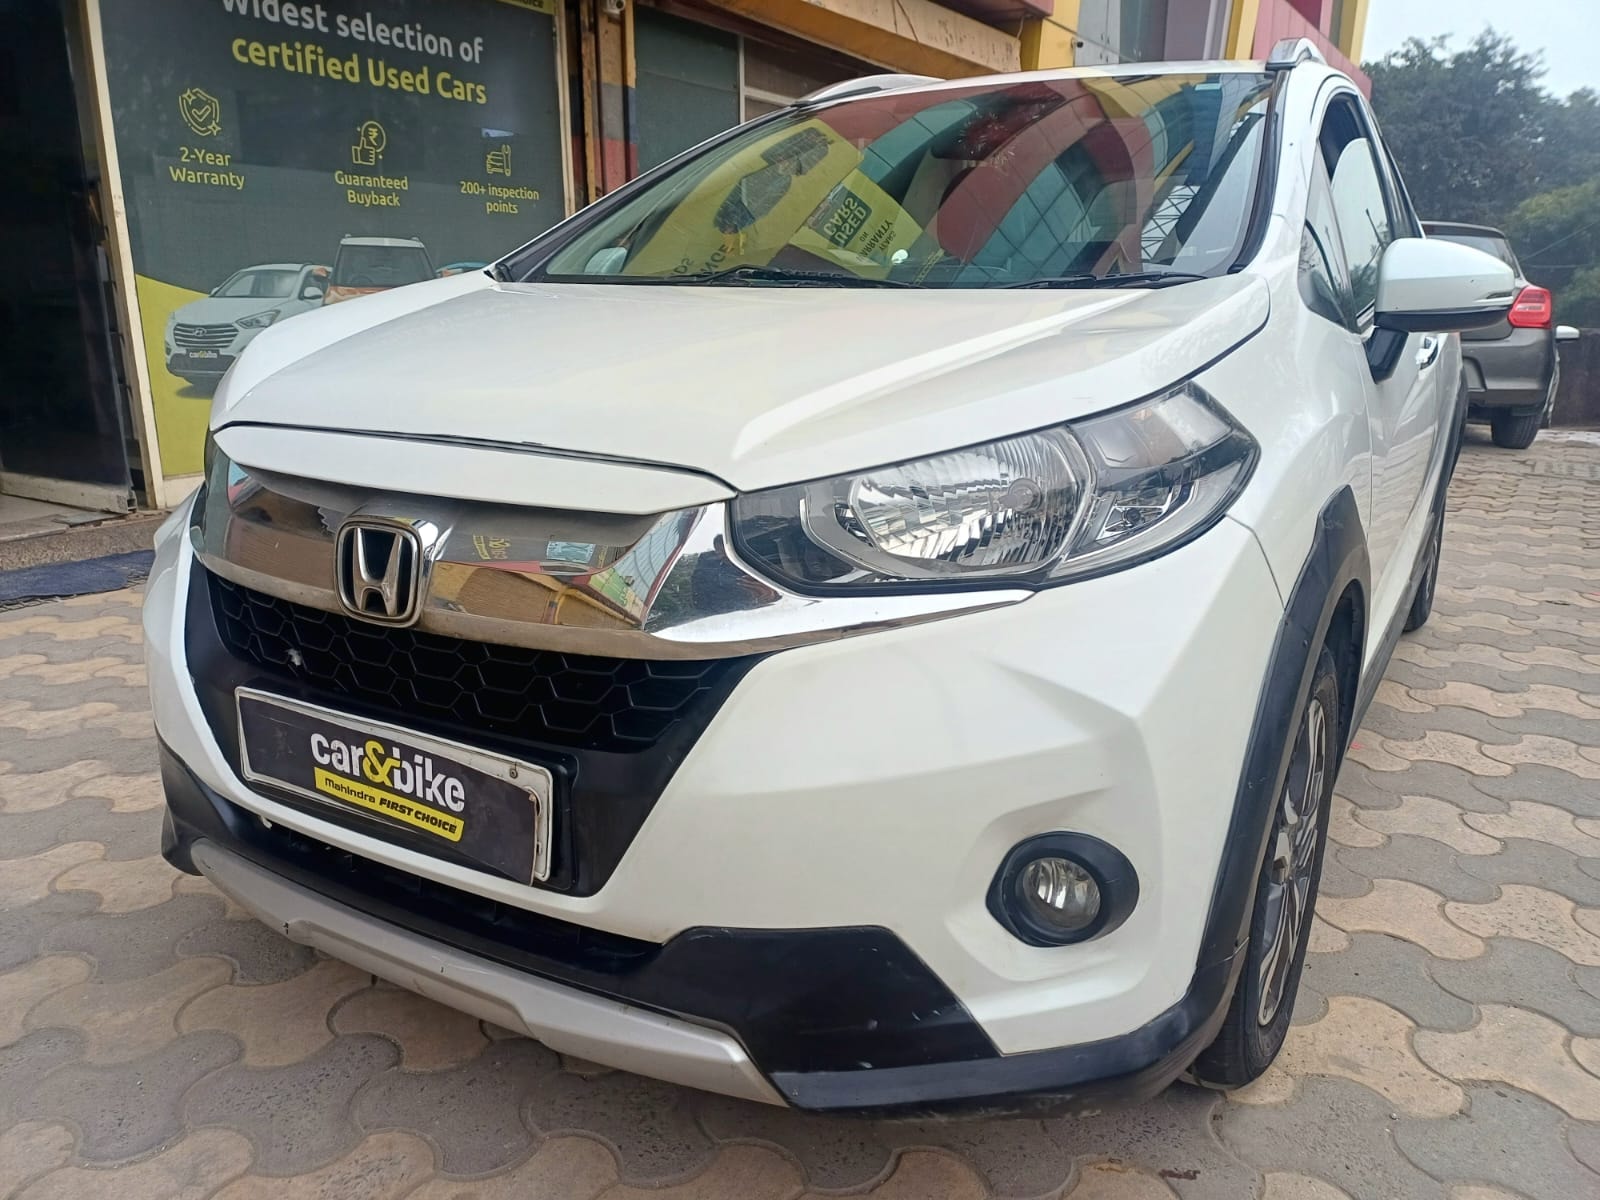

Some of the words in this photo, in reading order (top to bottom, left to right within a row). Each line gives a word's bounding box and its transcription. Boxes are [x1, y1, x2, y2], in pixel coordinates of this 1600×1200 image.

[336, 12, 453, 58] selection
[459, 36, 484, 64] of
[231, 38, 361, 83] certified
[367, 53, 430, 94] Used
[436, 71, 488, 104] Cars
[179, 146, 232, 167] 2-Year
[169, 166, 245, 190] Warranty
[334, 170, 409, 190] Guaranteed
[347, 189, 401, 207] Buyback
[460, 181, 486, 195] 200+
[487, 183, 540, 200] inspection
[486, 200, 519, 214] points
[310, 733, 465, 812] car&bike
[325, 777, 376, 803] Mahindra
[378, 797, 414, 817] FIRST
[413, 810, 457, 834] CHOICE
